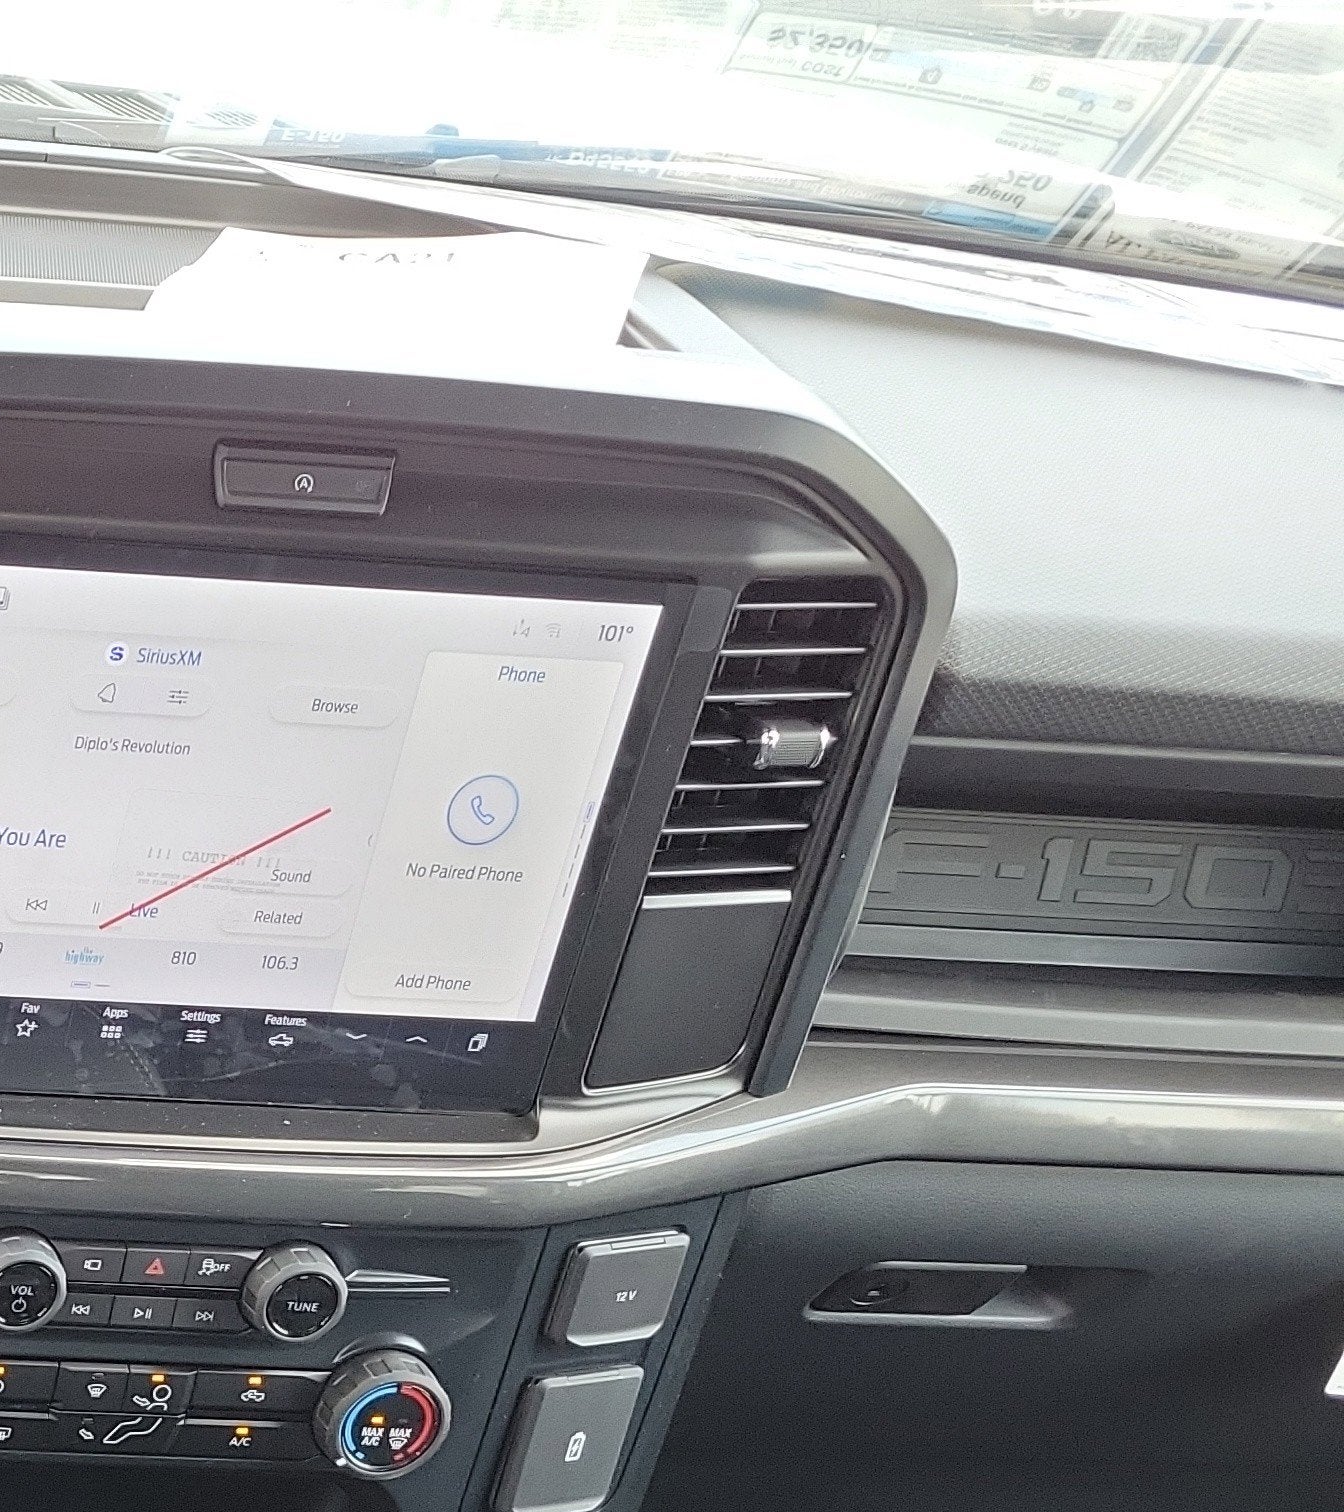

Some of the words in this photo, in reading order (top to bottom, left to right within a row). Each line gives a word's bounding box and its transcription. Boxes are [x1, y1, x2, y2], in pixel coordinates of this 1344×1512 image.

[598, 624, 634, 642] 101°
[136, 647, 203, 667] SiriusXM
[498, 665, 546, 684] Phone
[311, 698, 359, 714] Browse
[74, 735, 119, 754] Diplo's
[121, 738, 191, 756] Revolution
[33, 828, 67, 849] Are
[270, 868, 311, 884] Sound
[405, 862, 426, 879] No
[429, 863, 474, 881] Paired
[479, 866, 523, 883] Phone
[129, 902, 159, 919] Live
[254, 910, 303, 926] Related
[64, 951, 105, 966] highway
[170, 951, 196, 966] 810
[261, 954, 300, 971] 106.3
[394, 973, 424, 989] Add
[426, 975, 471, 991] Phone
[20, 1002, 41, 1015] Fav
[102, 1006, 129, 1021] Apps
[180, 1010, 221, 1025] Settings
[264, 1013, 308, 1028] Features
[213, 1262, 231, 1273] OFF
[10, 1285, 34, 1297] VOL
[286, 1301, 320, 1314] TUNE
[361, 1427, 385, 1437] MAX
[389, 1428, 412, 1438] MAX
[229, 1436, 252, 1447] A/C
[361, 1437, 380, 1446] A/C
